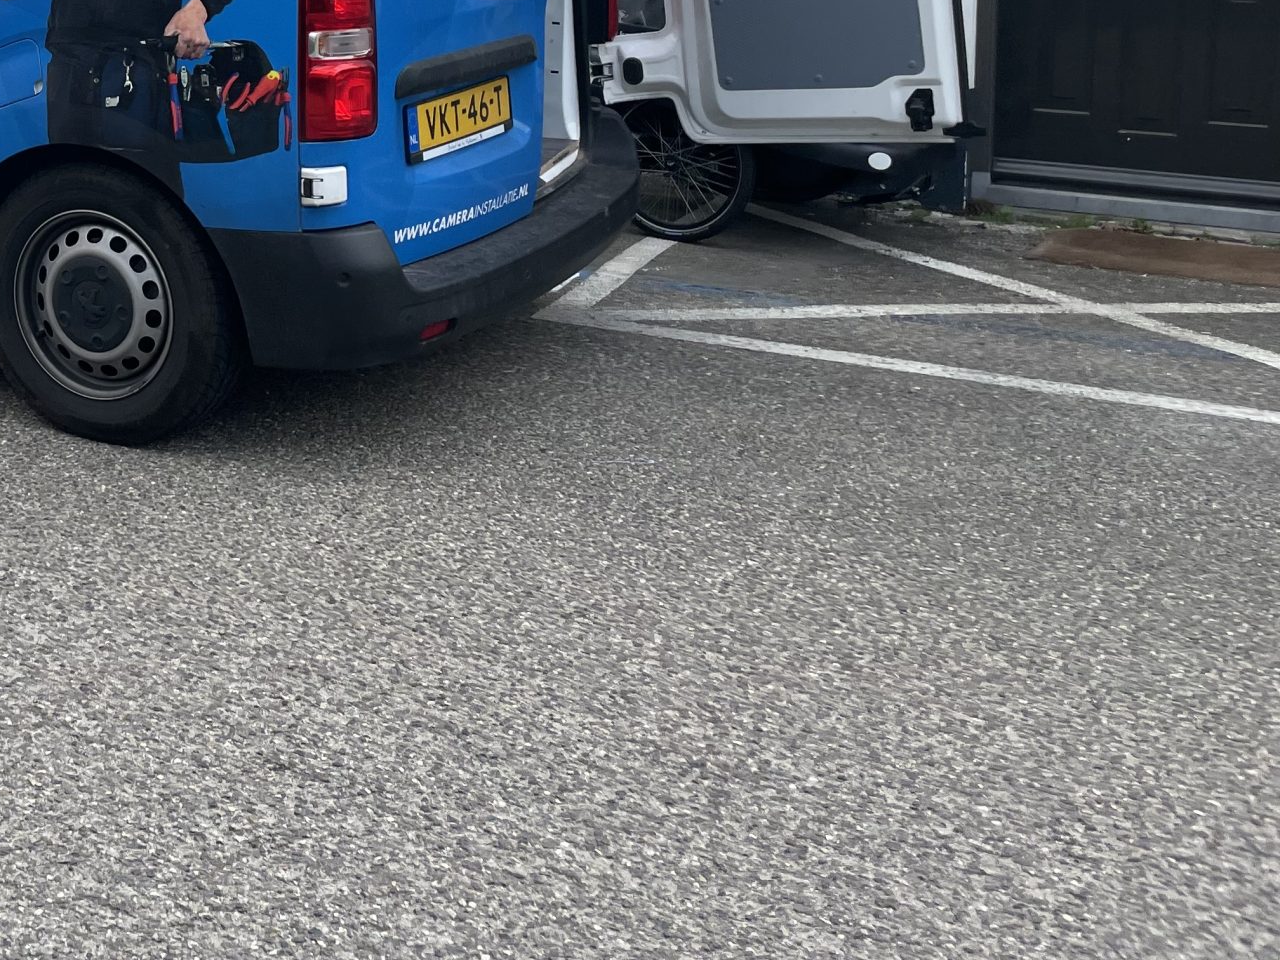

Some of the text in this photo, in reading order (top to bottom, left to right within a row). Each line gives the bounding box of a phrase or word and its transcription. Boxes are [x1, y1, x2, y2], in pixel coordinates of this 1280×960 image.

[409, 135, 419, 146] NL
[425, 84, 503, 141] VKT-46-T
[394, 183, 529, 244] WWW.CAMERAINSTALLATIE.NL
